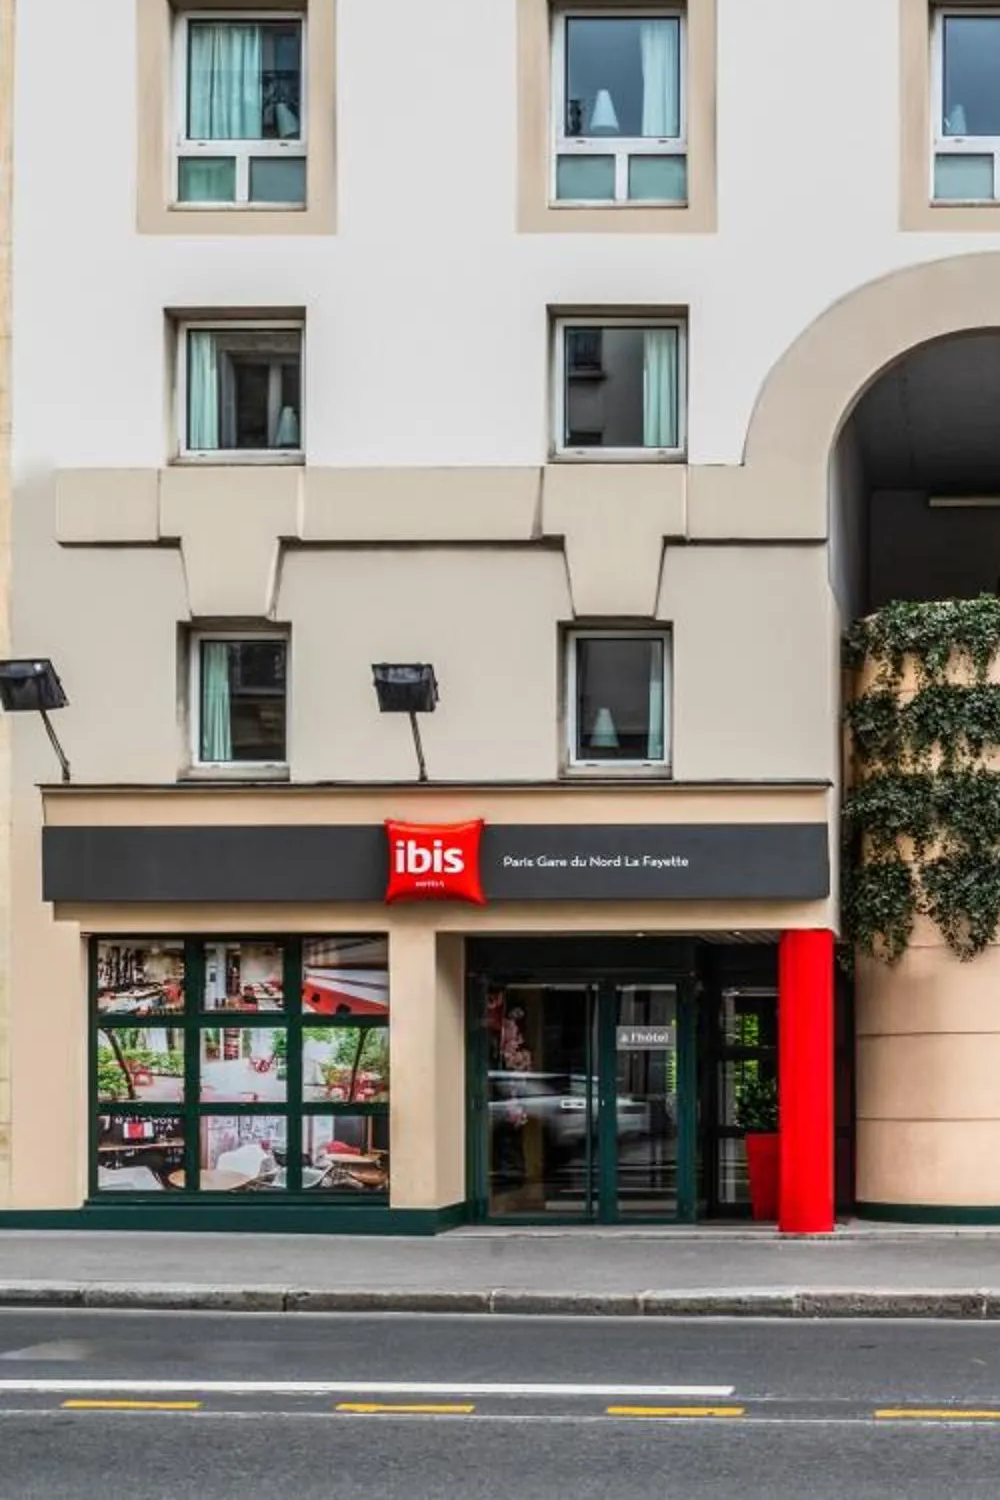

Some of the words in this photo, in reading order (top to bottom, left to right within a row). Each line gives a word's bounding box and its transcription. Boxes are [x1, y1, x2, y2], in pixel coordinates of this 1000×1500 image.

[395, 839, 464, 874] ibis
[503, 856, 534, 867] Paris
[537, 856, 567, 867] Gare
[570, 856, 587, 867] du
[589, 856, 620, 867] Nord
[625, 856, 639, 867] La
[643, 856, 689, 869] Fayette
